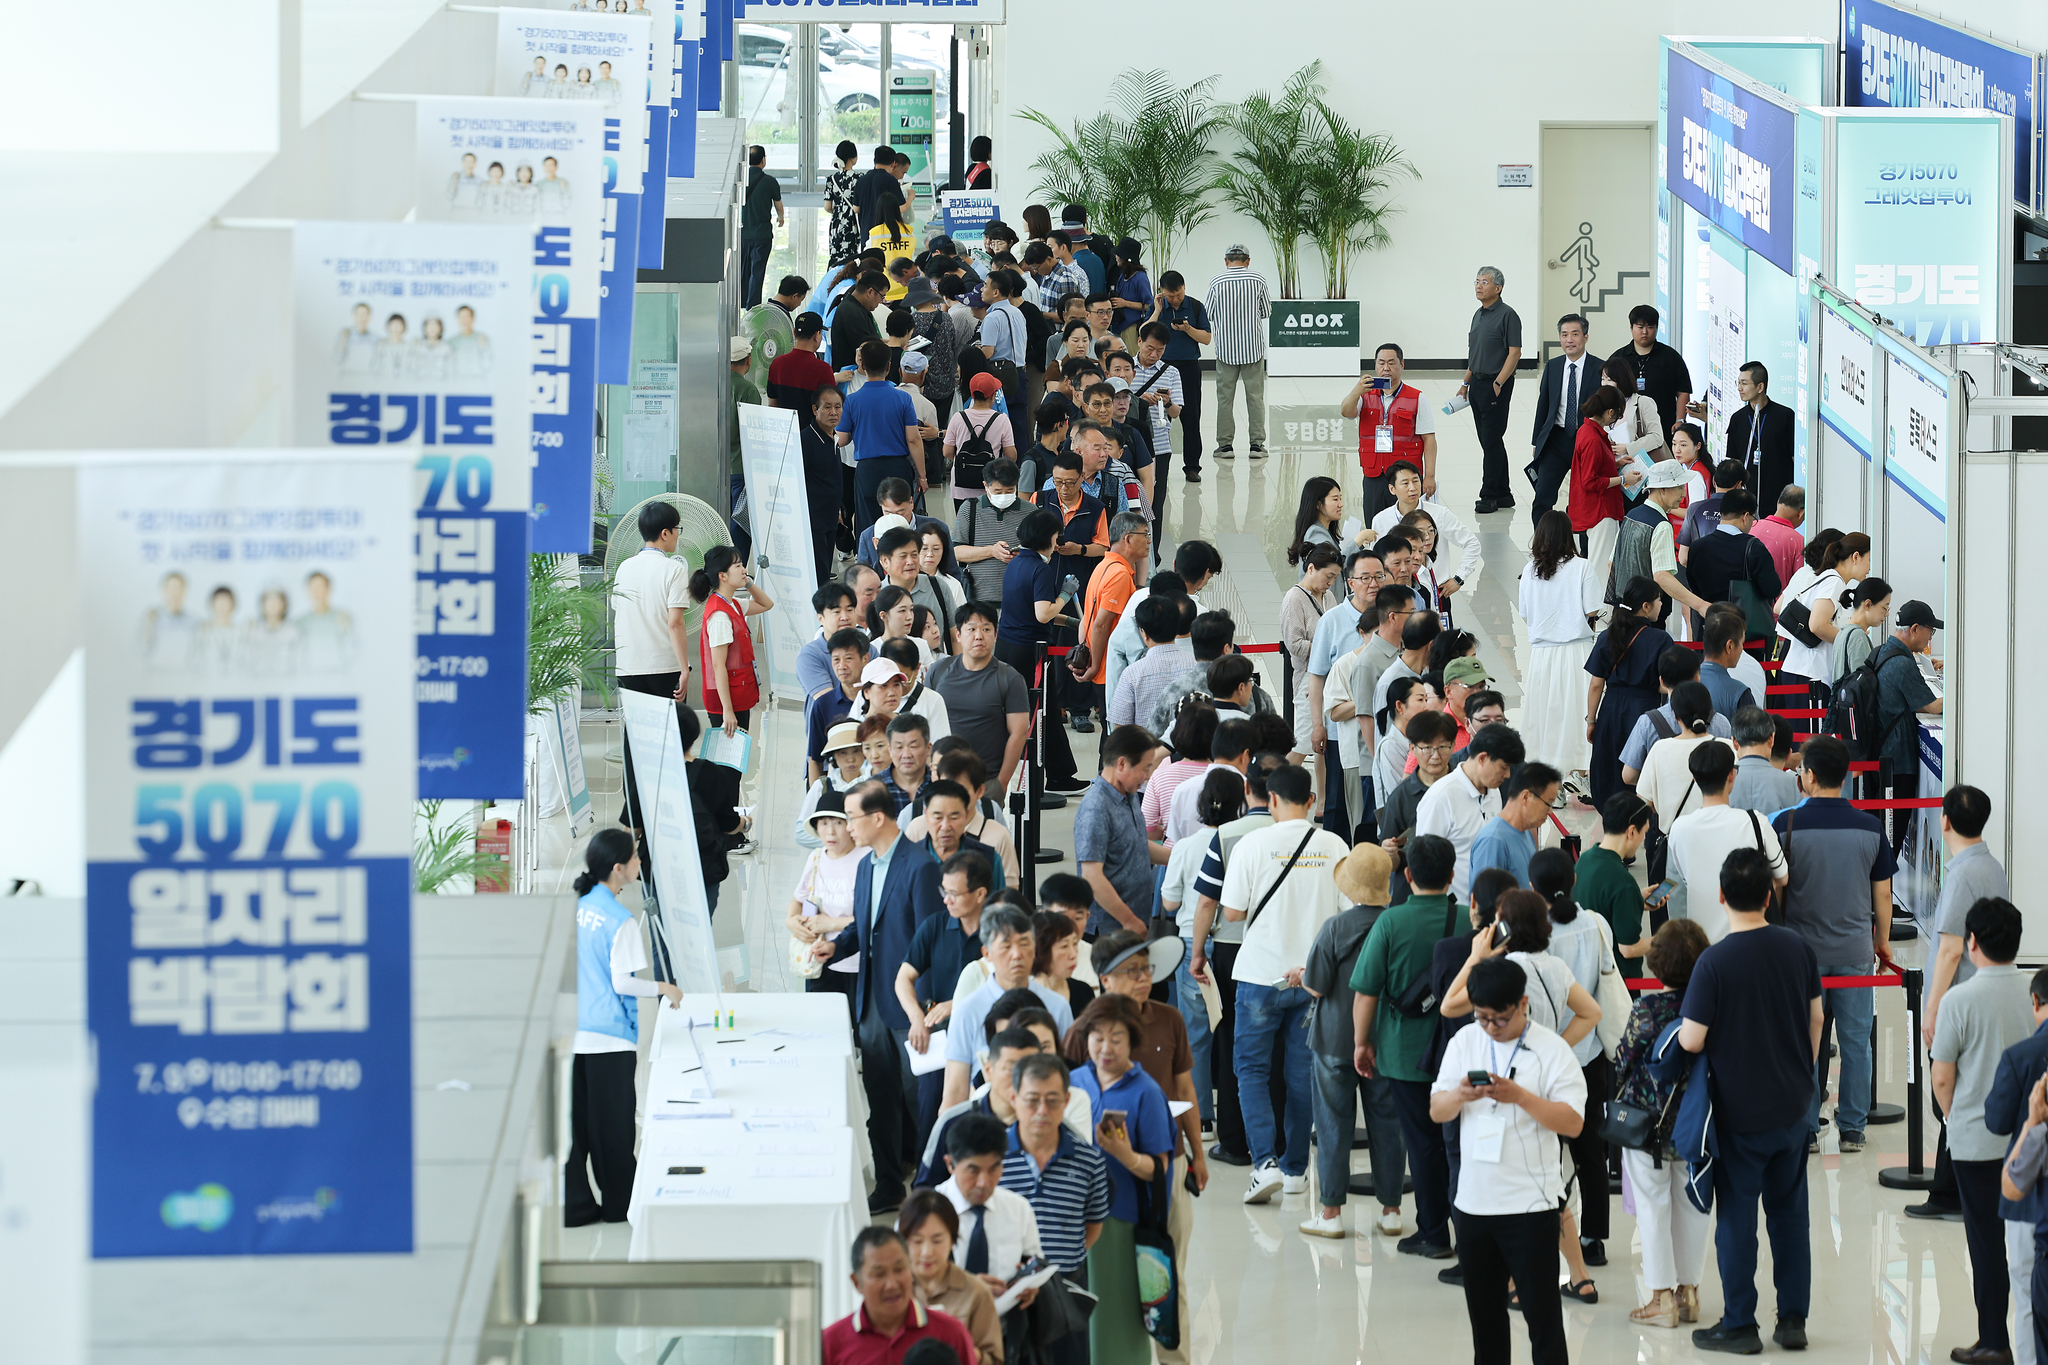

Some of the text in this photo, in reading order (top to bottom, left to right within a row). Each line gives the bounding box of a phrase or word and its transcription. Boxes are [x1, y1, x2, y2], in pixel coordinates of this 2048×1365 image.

[893, 98, 929, 106] 유료주차장
[1865, 187, 1972, 206] 그레잇잡투어
[1879, 163, 1958, 180] 경기5070
[880, 241, 909, 251] STAFF
[1855, 264, 1980, 305] 경기도
[1891, 309, 1981, 346] 070
[1841, 355, 1865, 406] 안내데스크
[328, 392, 495, 445] 경기도
[1910, 407, 1937, 462] 등록데스크
[129, 697, 362, 769] 경기도
[135, 782, 362, 860] 5070
[128, 867, 368, 949] 일자리
[128, 952, 370, 1035] 박람회
